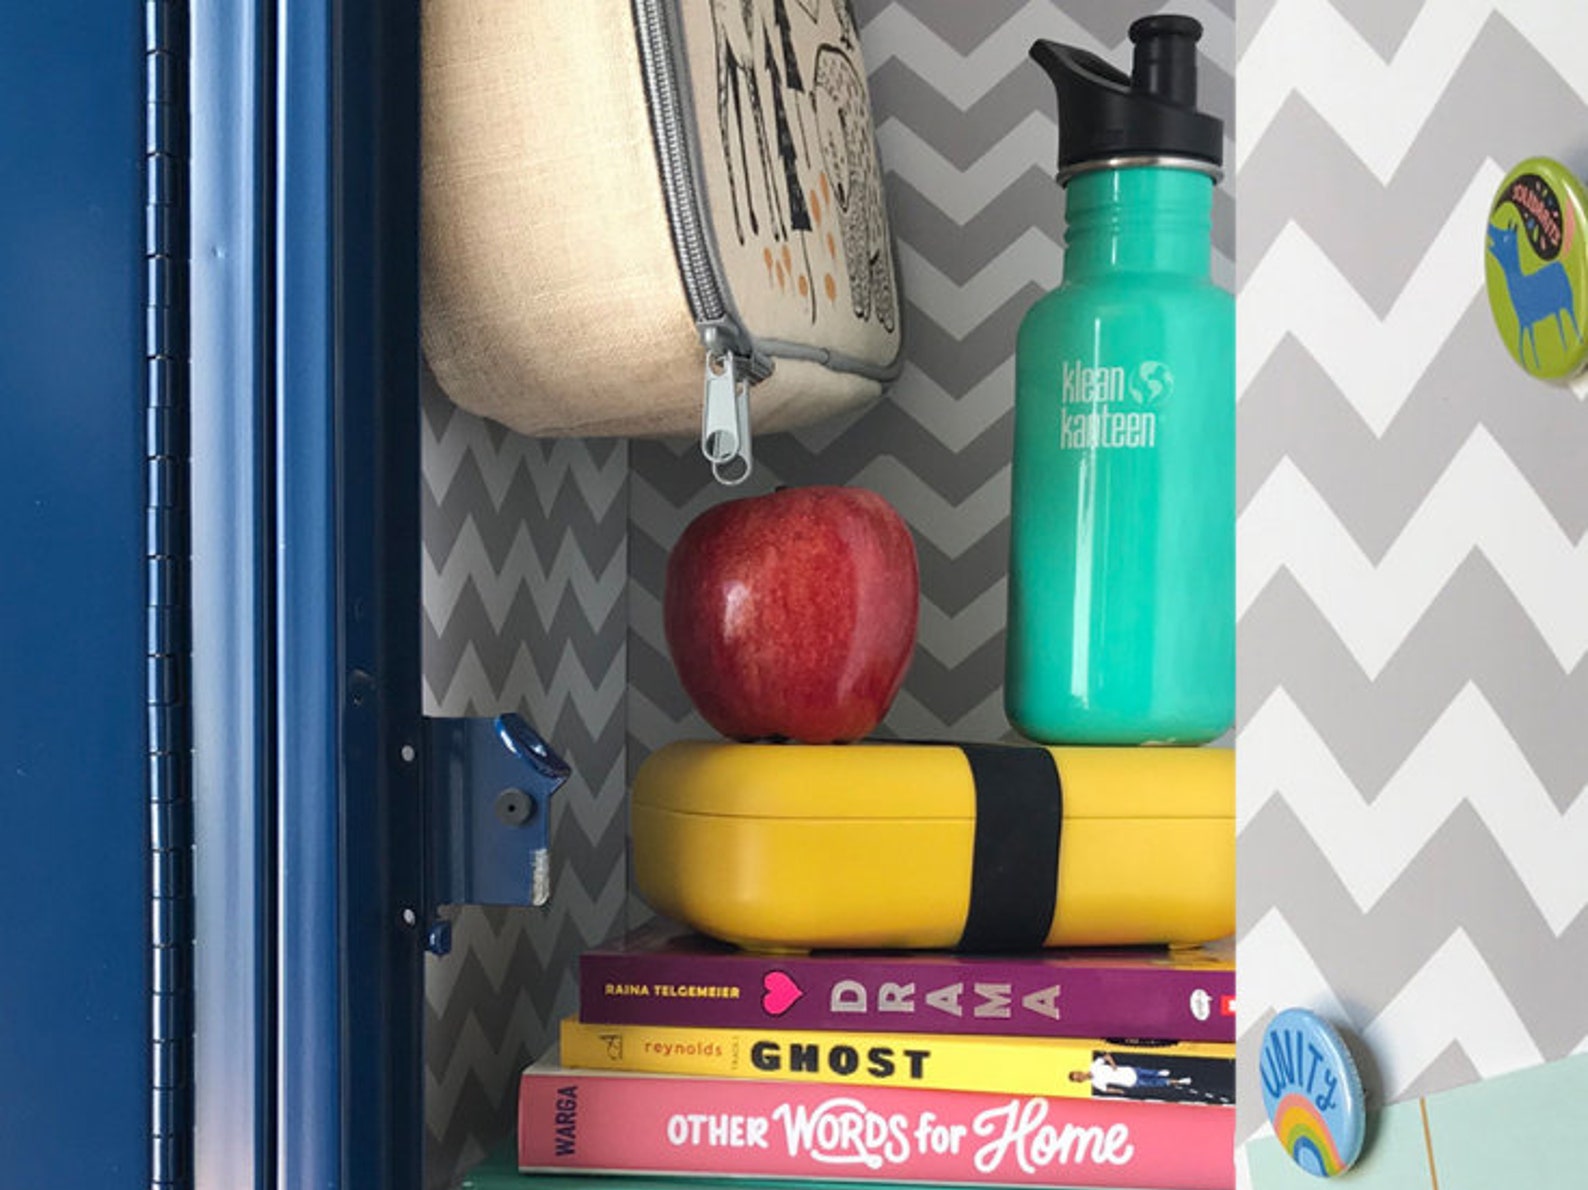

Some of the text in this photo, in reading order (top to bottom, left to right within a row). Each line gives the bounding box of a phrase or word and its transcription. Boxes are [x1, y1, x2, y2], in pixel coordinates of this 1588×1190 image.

[1062, 360, 1124, 403] klean
[1060, 404, 1155, 450] kanteen
[604, 983, 741, 999] RAINA TELGEMEIER
[829, 980, 1061, 1020] DRAMA
[645, 1042, 723, 1056] reynolds
[750, 1040, 931, 1079] GHOST
[556, 1085, 579, 1156] WARGA
[666, 1097, 1134, 1173] OTHER WORDS for Home
